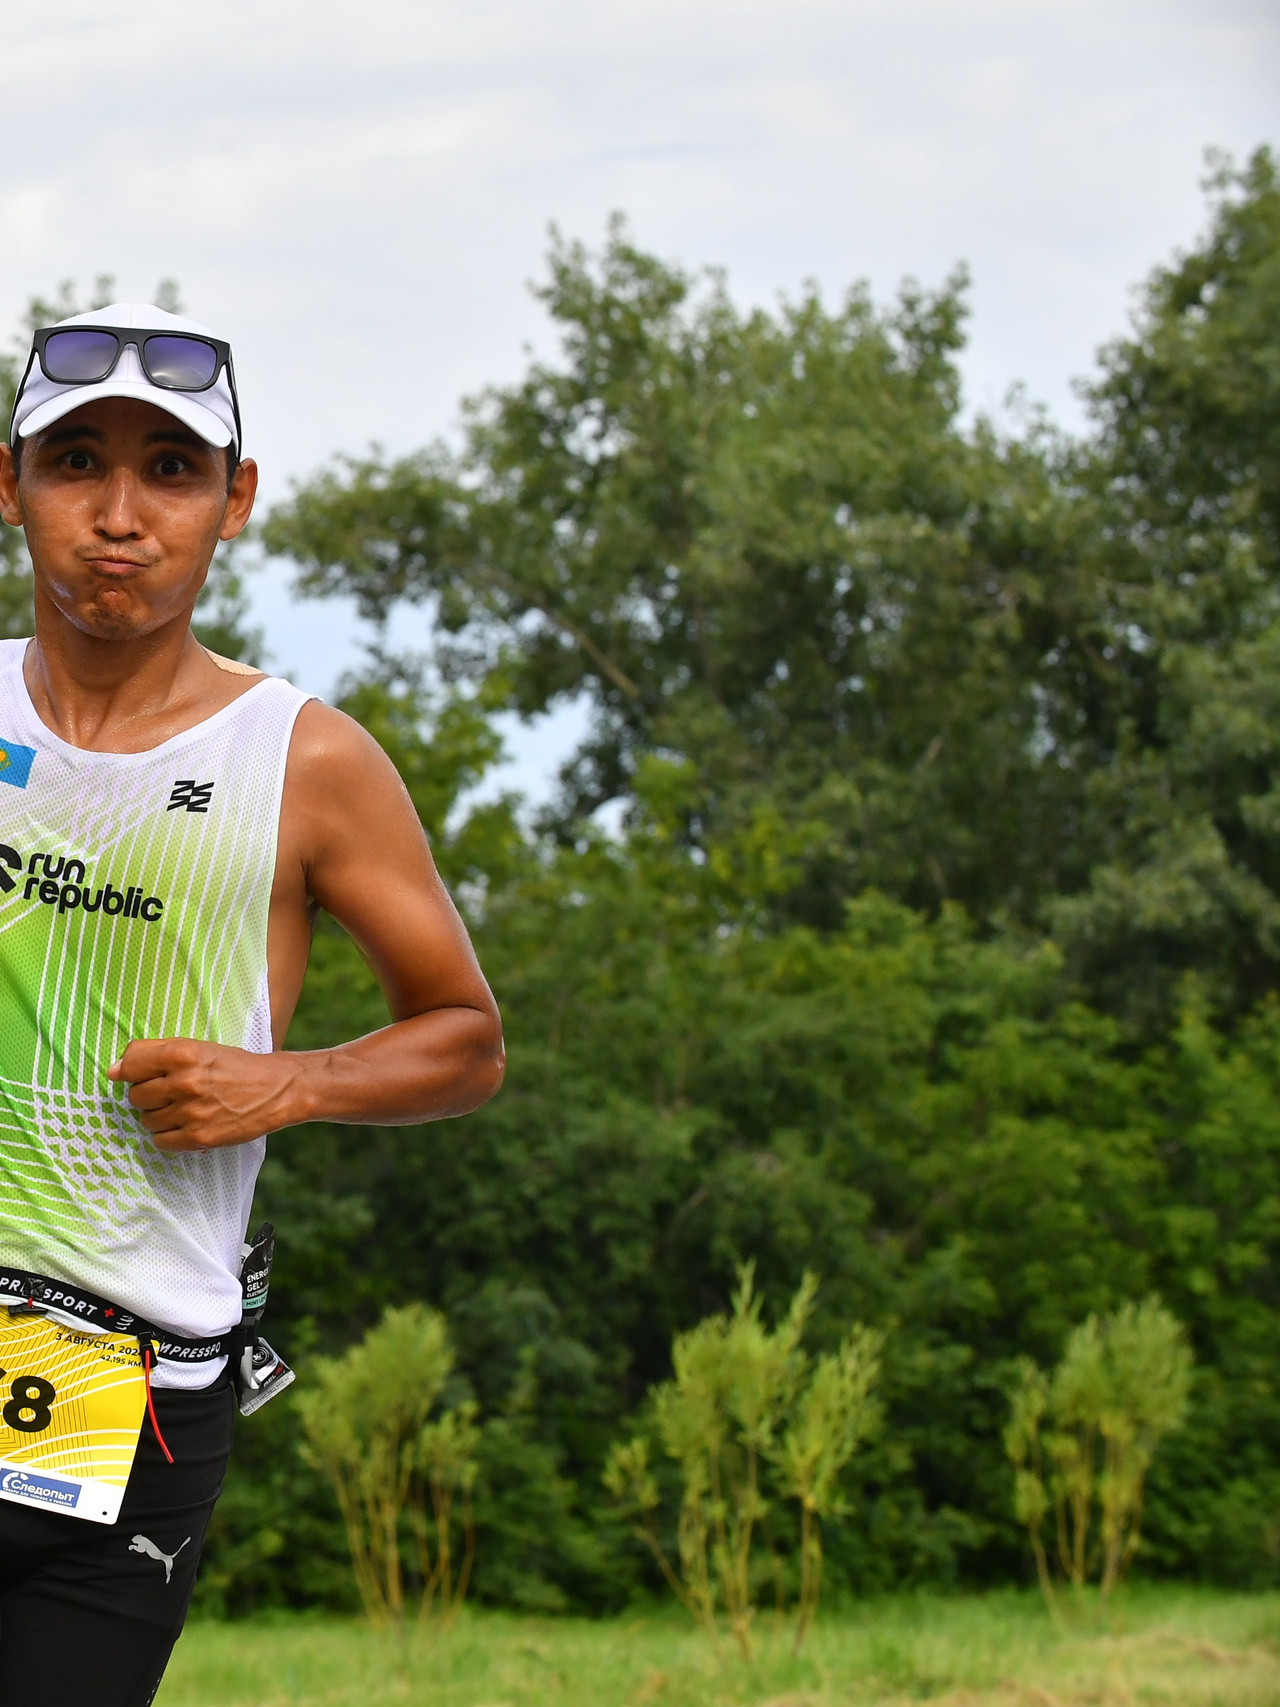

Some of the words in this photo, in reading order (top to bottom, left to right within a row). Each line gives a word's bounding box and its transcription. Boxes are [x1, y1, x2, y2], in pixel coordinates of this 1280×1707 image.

[27, 852, 86, 884] run
[23, 876, 163, 922] republic
[55, 1332, 62, 1341] 3
[64, 1334, 116, 1352] АВГУСТА
[100, 1354, 126, 1365] 42,195
[10, 1479, 75, 1502] Следопыт
